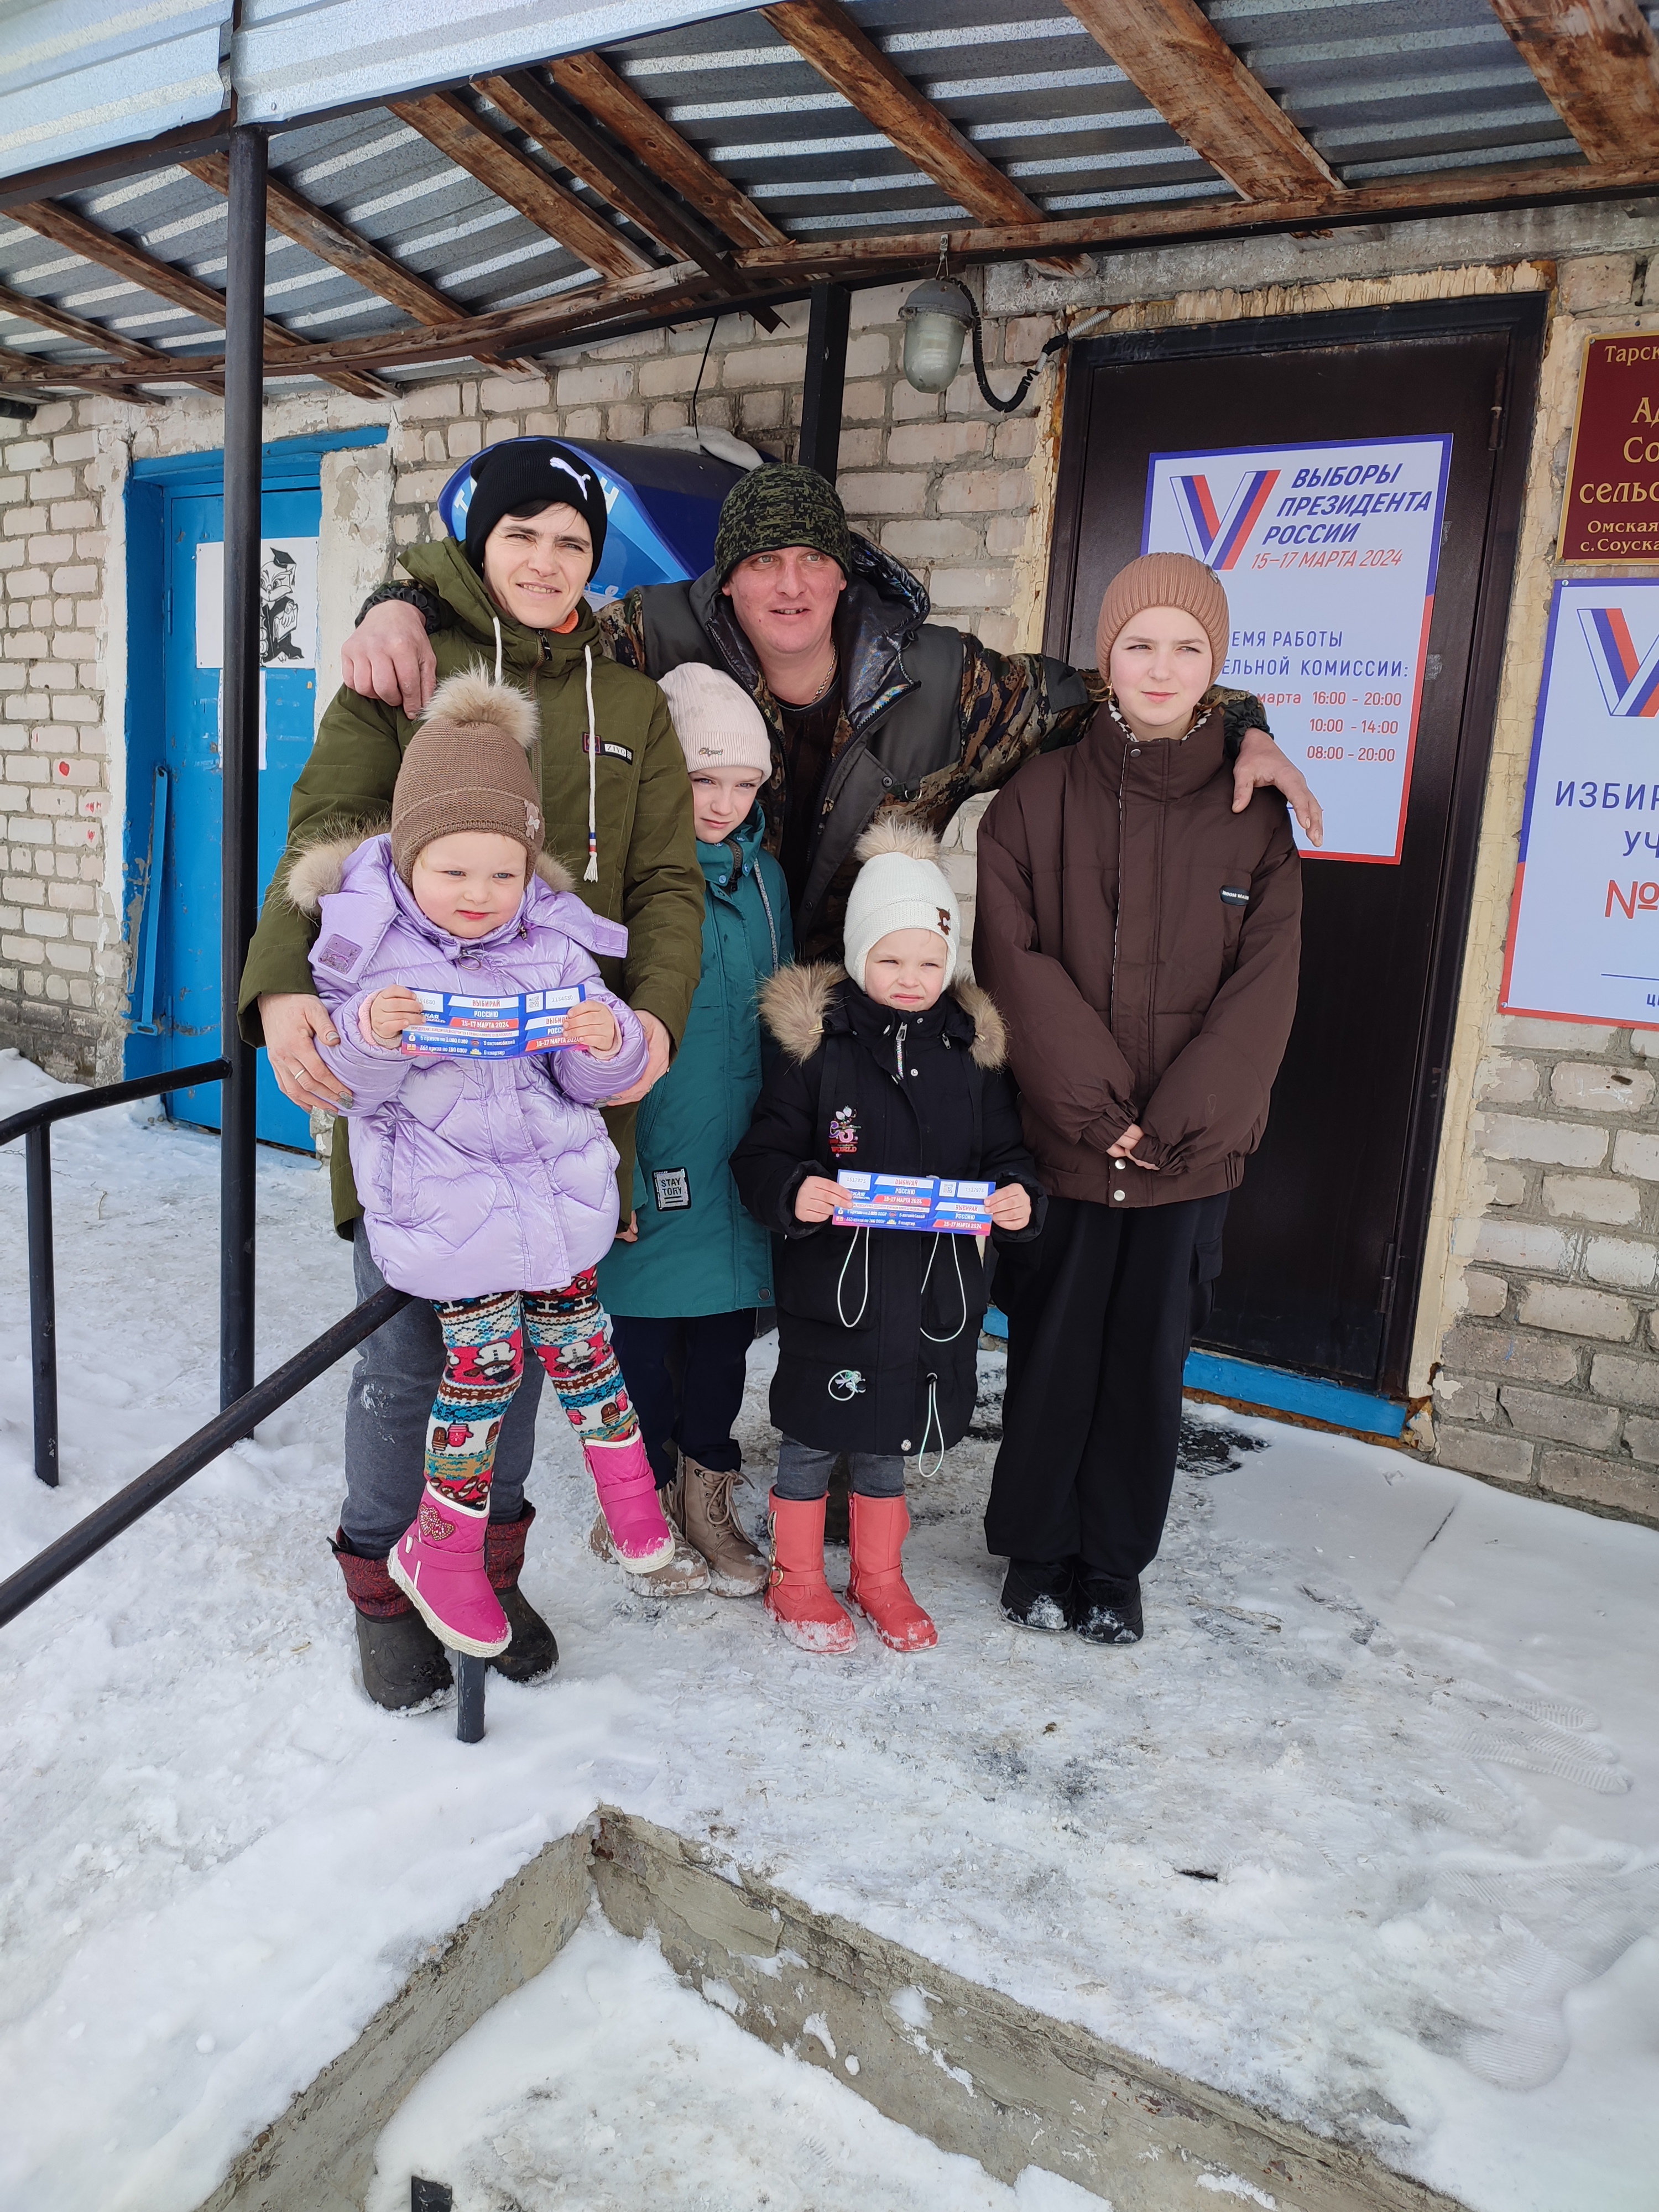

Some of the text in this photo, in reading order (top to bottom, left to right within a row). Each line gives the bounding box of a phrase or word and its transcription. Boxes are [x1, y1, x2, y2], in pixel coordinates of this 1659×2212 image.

[1291, 463, 1404, 489] ВЫБОРЫ
[1276, 491, 1432, 518] ПРЕЗИДЕНТА
[1261, 523, 1361, 545] РОССИИ
[1587, 520, 1659, 533] Омская
[1298, 550, 1358, 568] МАРТА
[1359, 549, 1403, 567] 2024
[1232, 631, 1342, 647] ЕМЯ РАБОТЫ
[1222, 656, 1408, 677] ЕЛЬНОЙ КОМИССИИ:
[1256, 692, 1301, 706] марта
[1313, 691, 1346, 705] 16:00
[1364, 692, 1402, 706] 20:00
[1310, 718, 1343, 732] 10:00
[1361, 720, 1398, 734] 14:00
[1307, 745, 1344, 760] 08:00
[1358, 748, 1395, 761] 20:00
[661, 1177, 681, 1187] STAY
[662, 1187, 682, 1196] TORY
